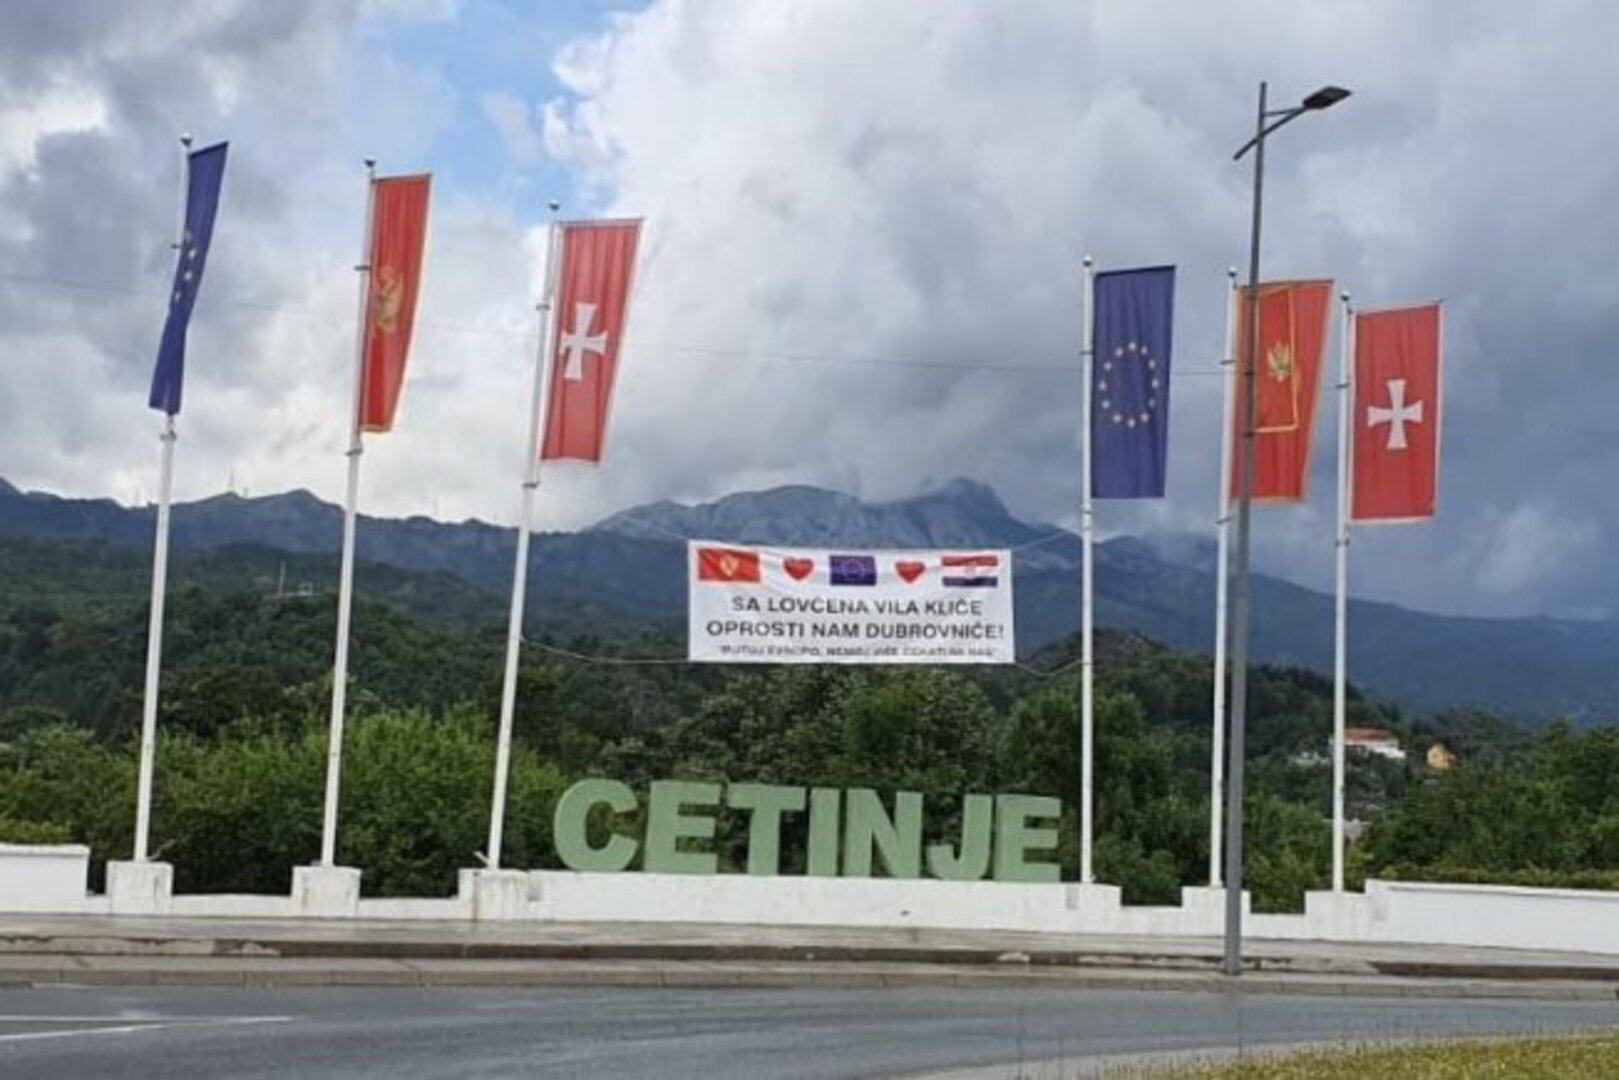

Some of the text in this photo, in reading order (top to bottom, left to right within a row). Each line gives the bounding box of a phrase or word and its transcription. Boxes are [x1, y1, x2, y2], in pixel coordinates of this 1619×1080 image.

[732, 596, 760, 611] SA
[874, 600, 919, 614] VILA
[706, 620, 805, 636] OPROSTI
[811, 623, 859, 637] NAM
[553, 778, 1062, 882] CETINJE
